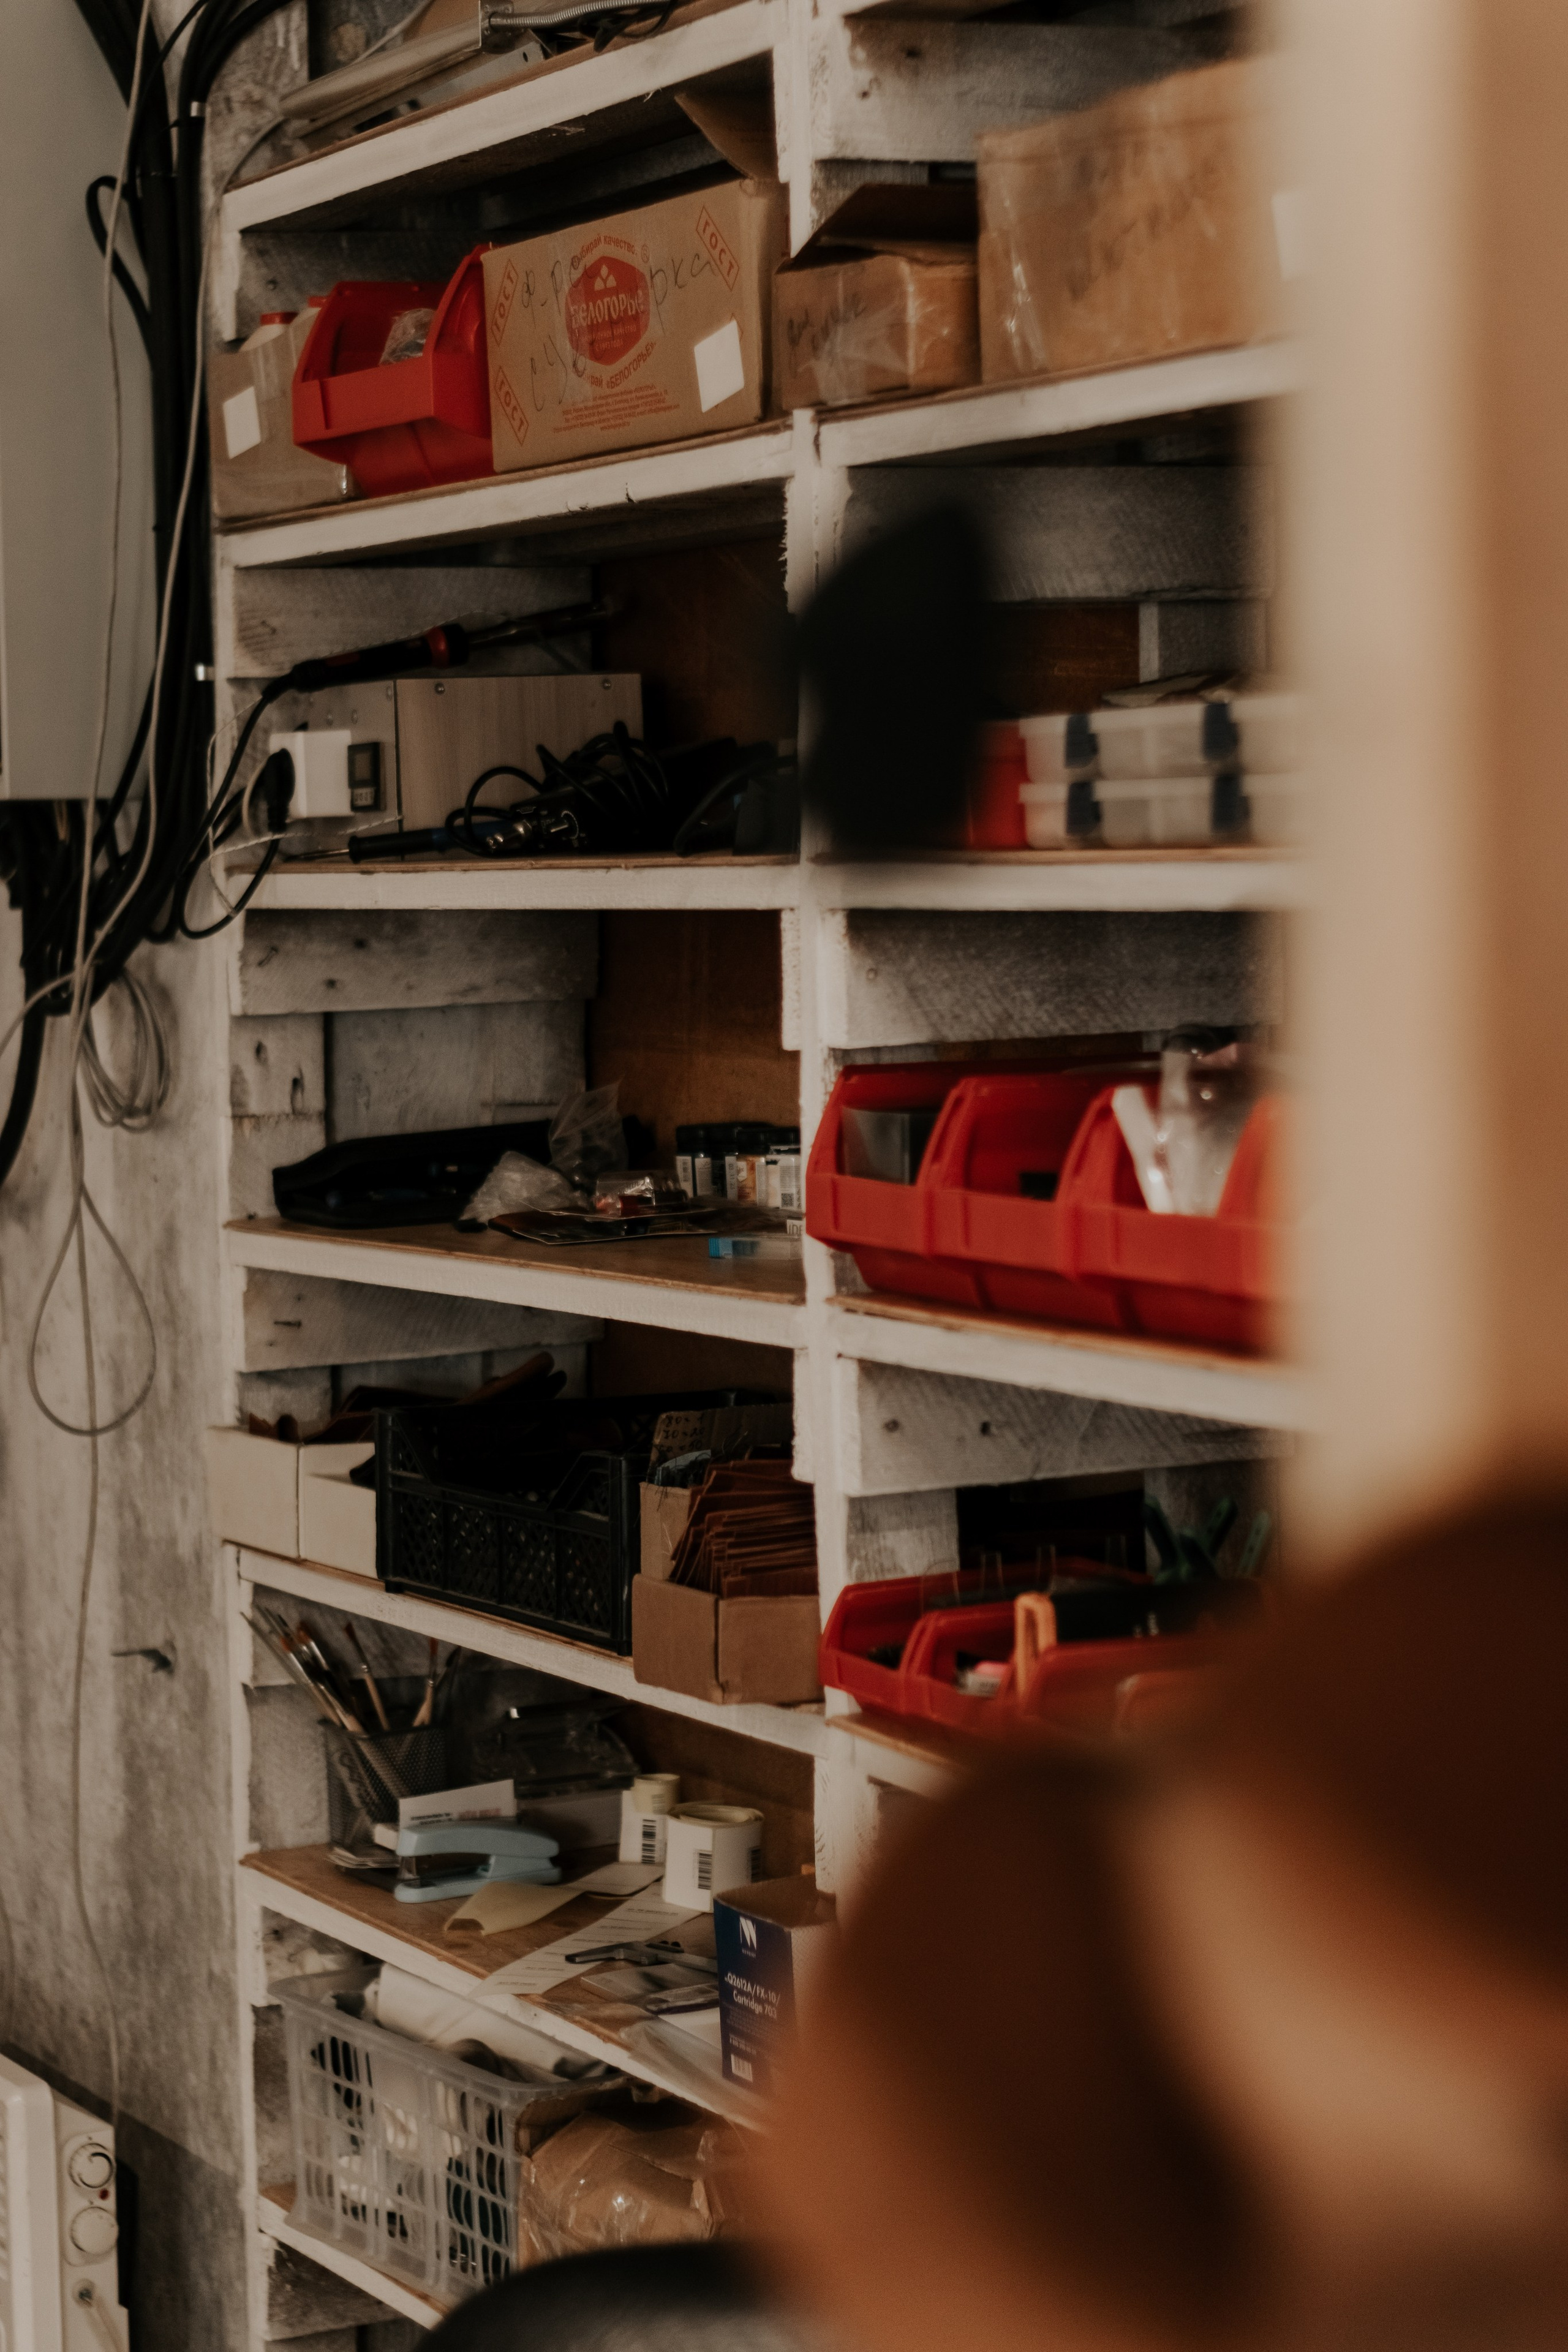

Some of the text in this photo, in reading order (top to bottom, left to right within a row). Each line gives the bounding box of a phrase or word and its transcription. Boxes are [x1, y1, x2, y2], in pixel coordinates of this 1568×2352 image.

[702, 219, 734, 277] ГОСТ
[494, 270, 514, 333] ГОСТ
[499, 379, 525, 432] ГОСТ
[733, 1989, 763, 2015] Cartridge
